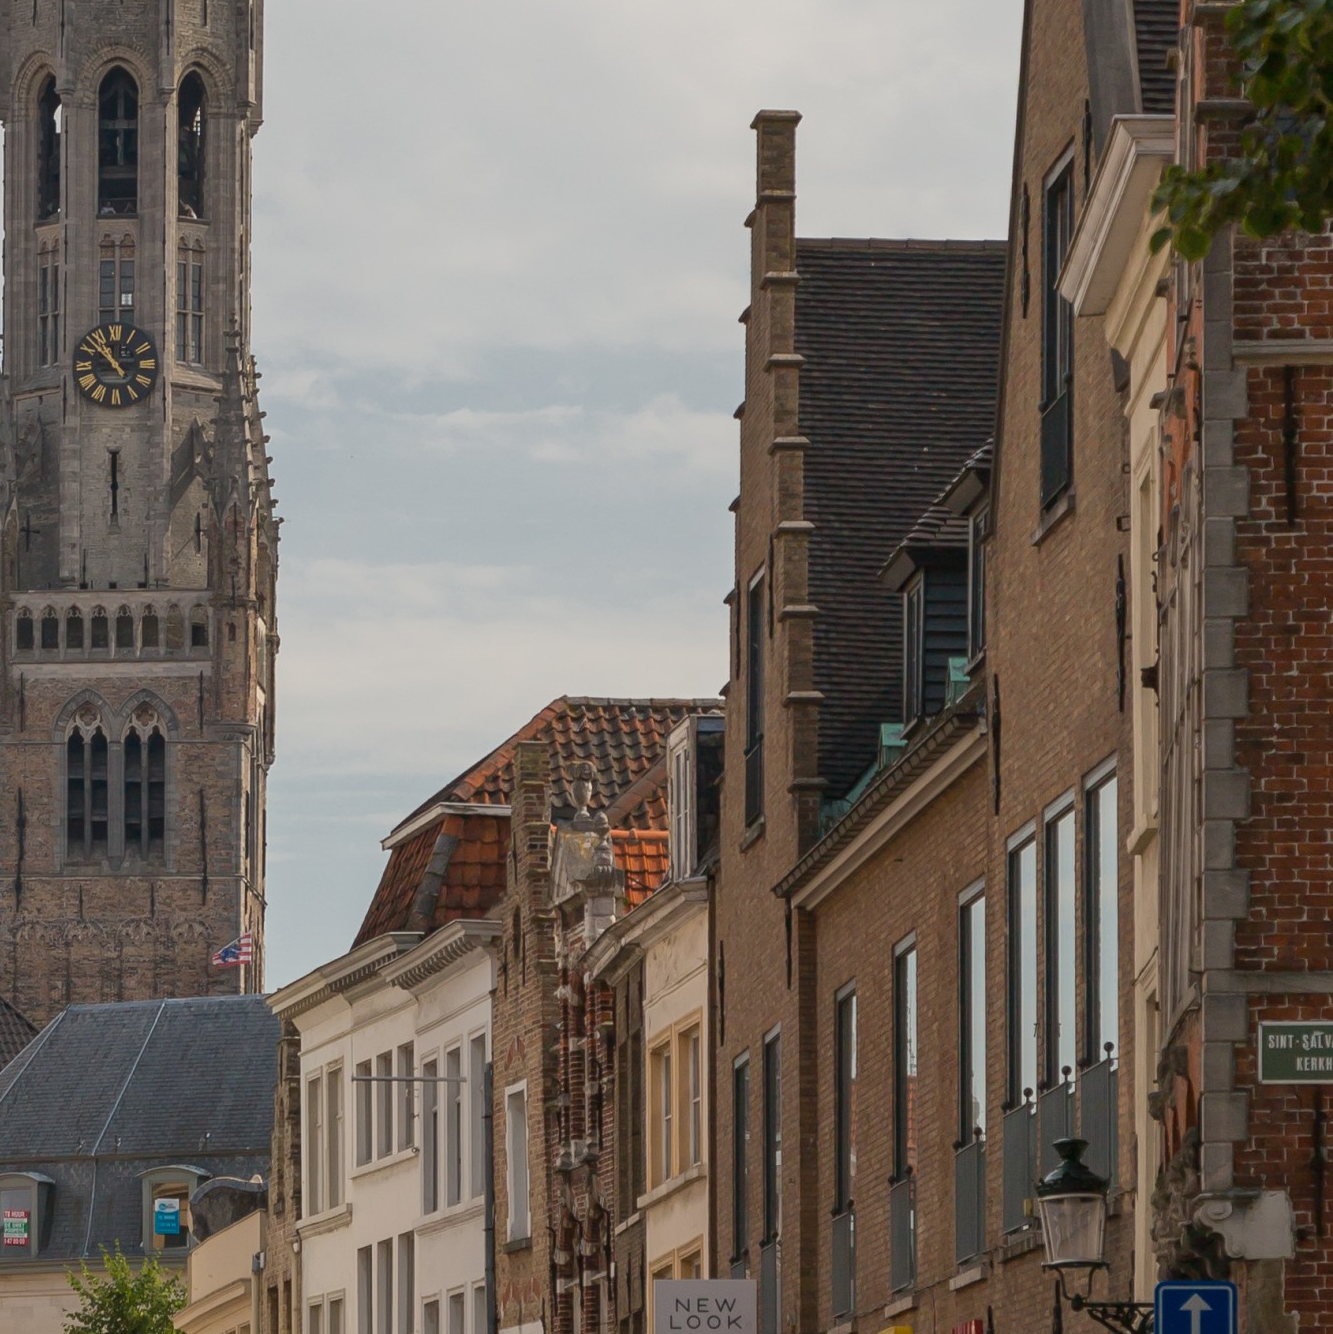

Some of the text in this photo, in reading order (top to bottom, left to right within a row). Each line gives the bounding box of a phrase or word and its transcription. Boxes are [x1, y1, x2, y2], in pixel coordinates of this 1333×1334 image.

[1296, 1057, 1333, 1071] KERKH
[675, 1298, 737, 1313] NEW
[669, 1315, 743, 1330] LOOK
